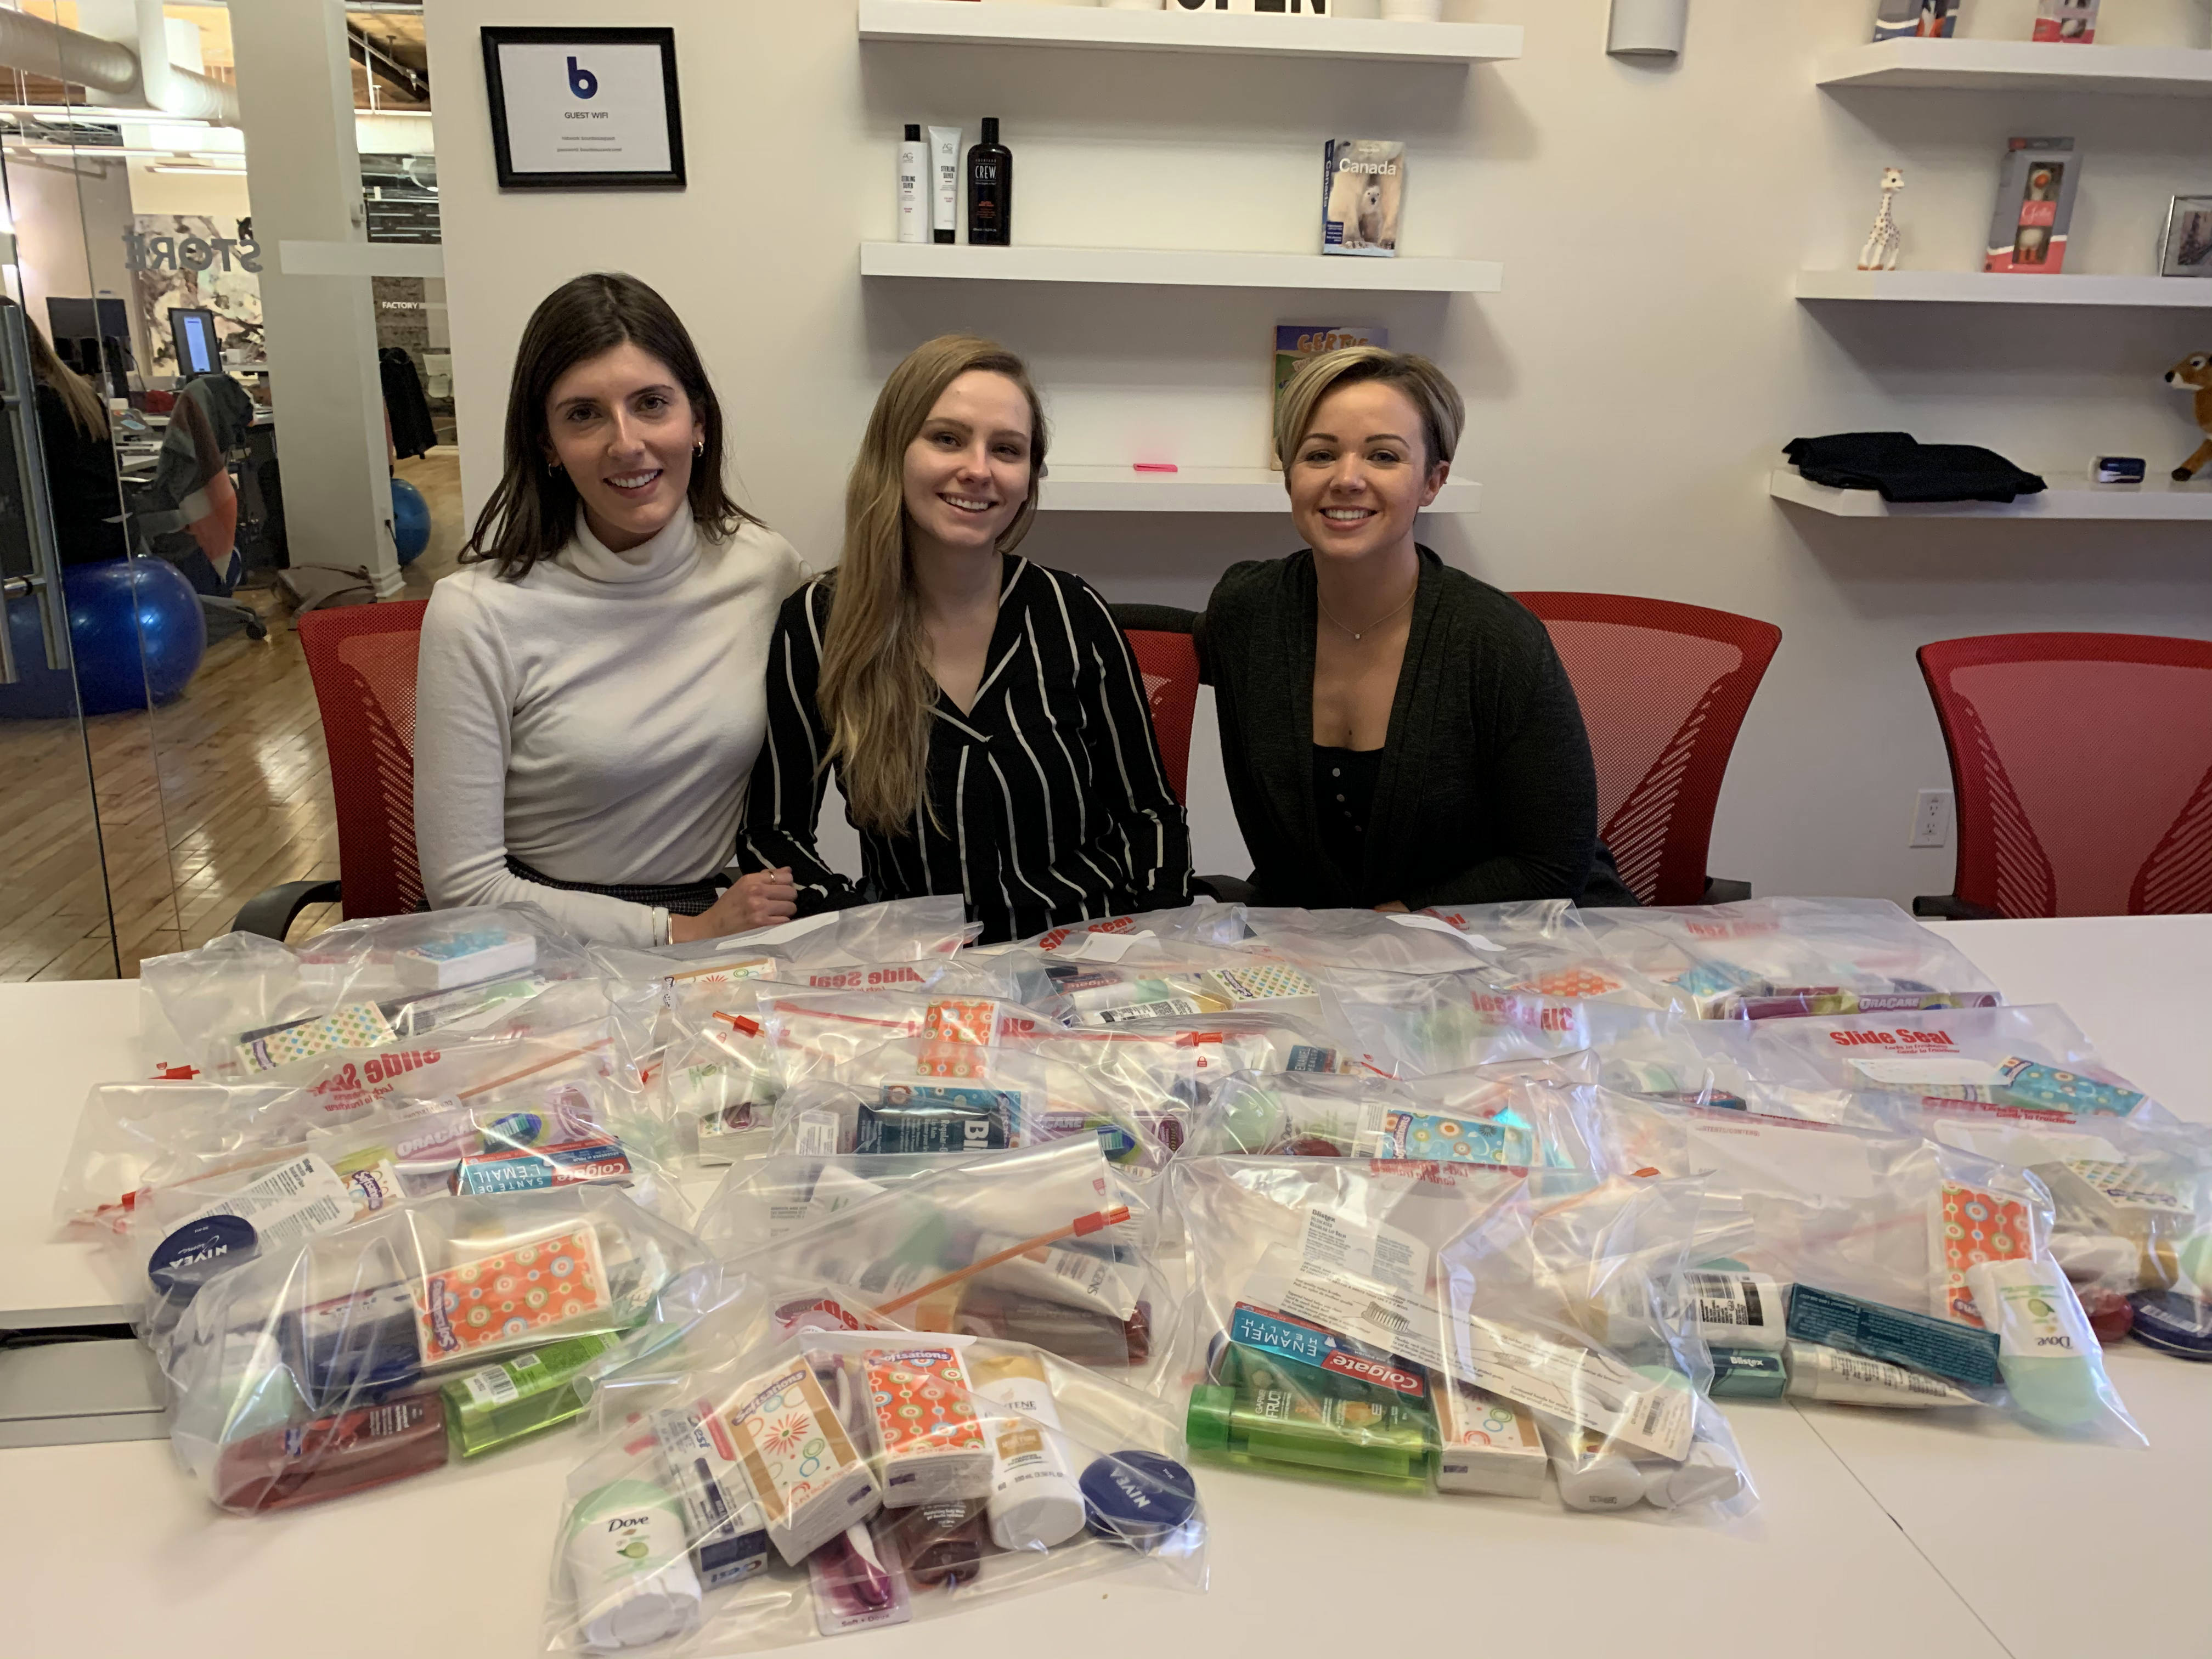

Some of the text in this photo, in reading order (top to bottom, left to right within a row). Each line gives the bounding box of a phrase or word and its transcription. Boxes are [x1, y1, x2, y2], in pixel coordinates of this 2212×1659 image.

[975, 166, 996, 179] CREW
[1339, 158, 1396, 176] Canada
[1830, 1029, 1955, 1046] Slide Seal
[474, 1164, 540, 1183] L'ÉMAIL
[557, 1163, 624, 1181] Colgate
[499, 1178, 544, 1192] SANTÉ
[1311, 1209, 1336, 1223] Blistex
[170, 1245, 227, 1269] NIVEA
[1242, 1325, 1318, 1357] ENAMEL
[1246, 1319, 1318, 1345] HEALTH
[2038, 1336, 2073, 1349] Dove
[1730, 1356, 1764, 1367] Blistex
[1333, 1355, 1419, 1390] Colgate
[734, 1371, 805, 1424] Softsations
[1110, 1466, 1151, 1508] NIVEA
[608, 1515, 650, 1533] Dove
